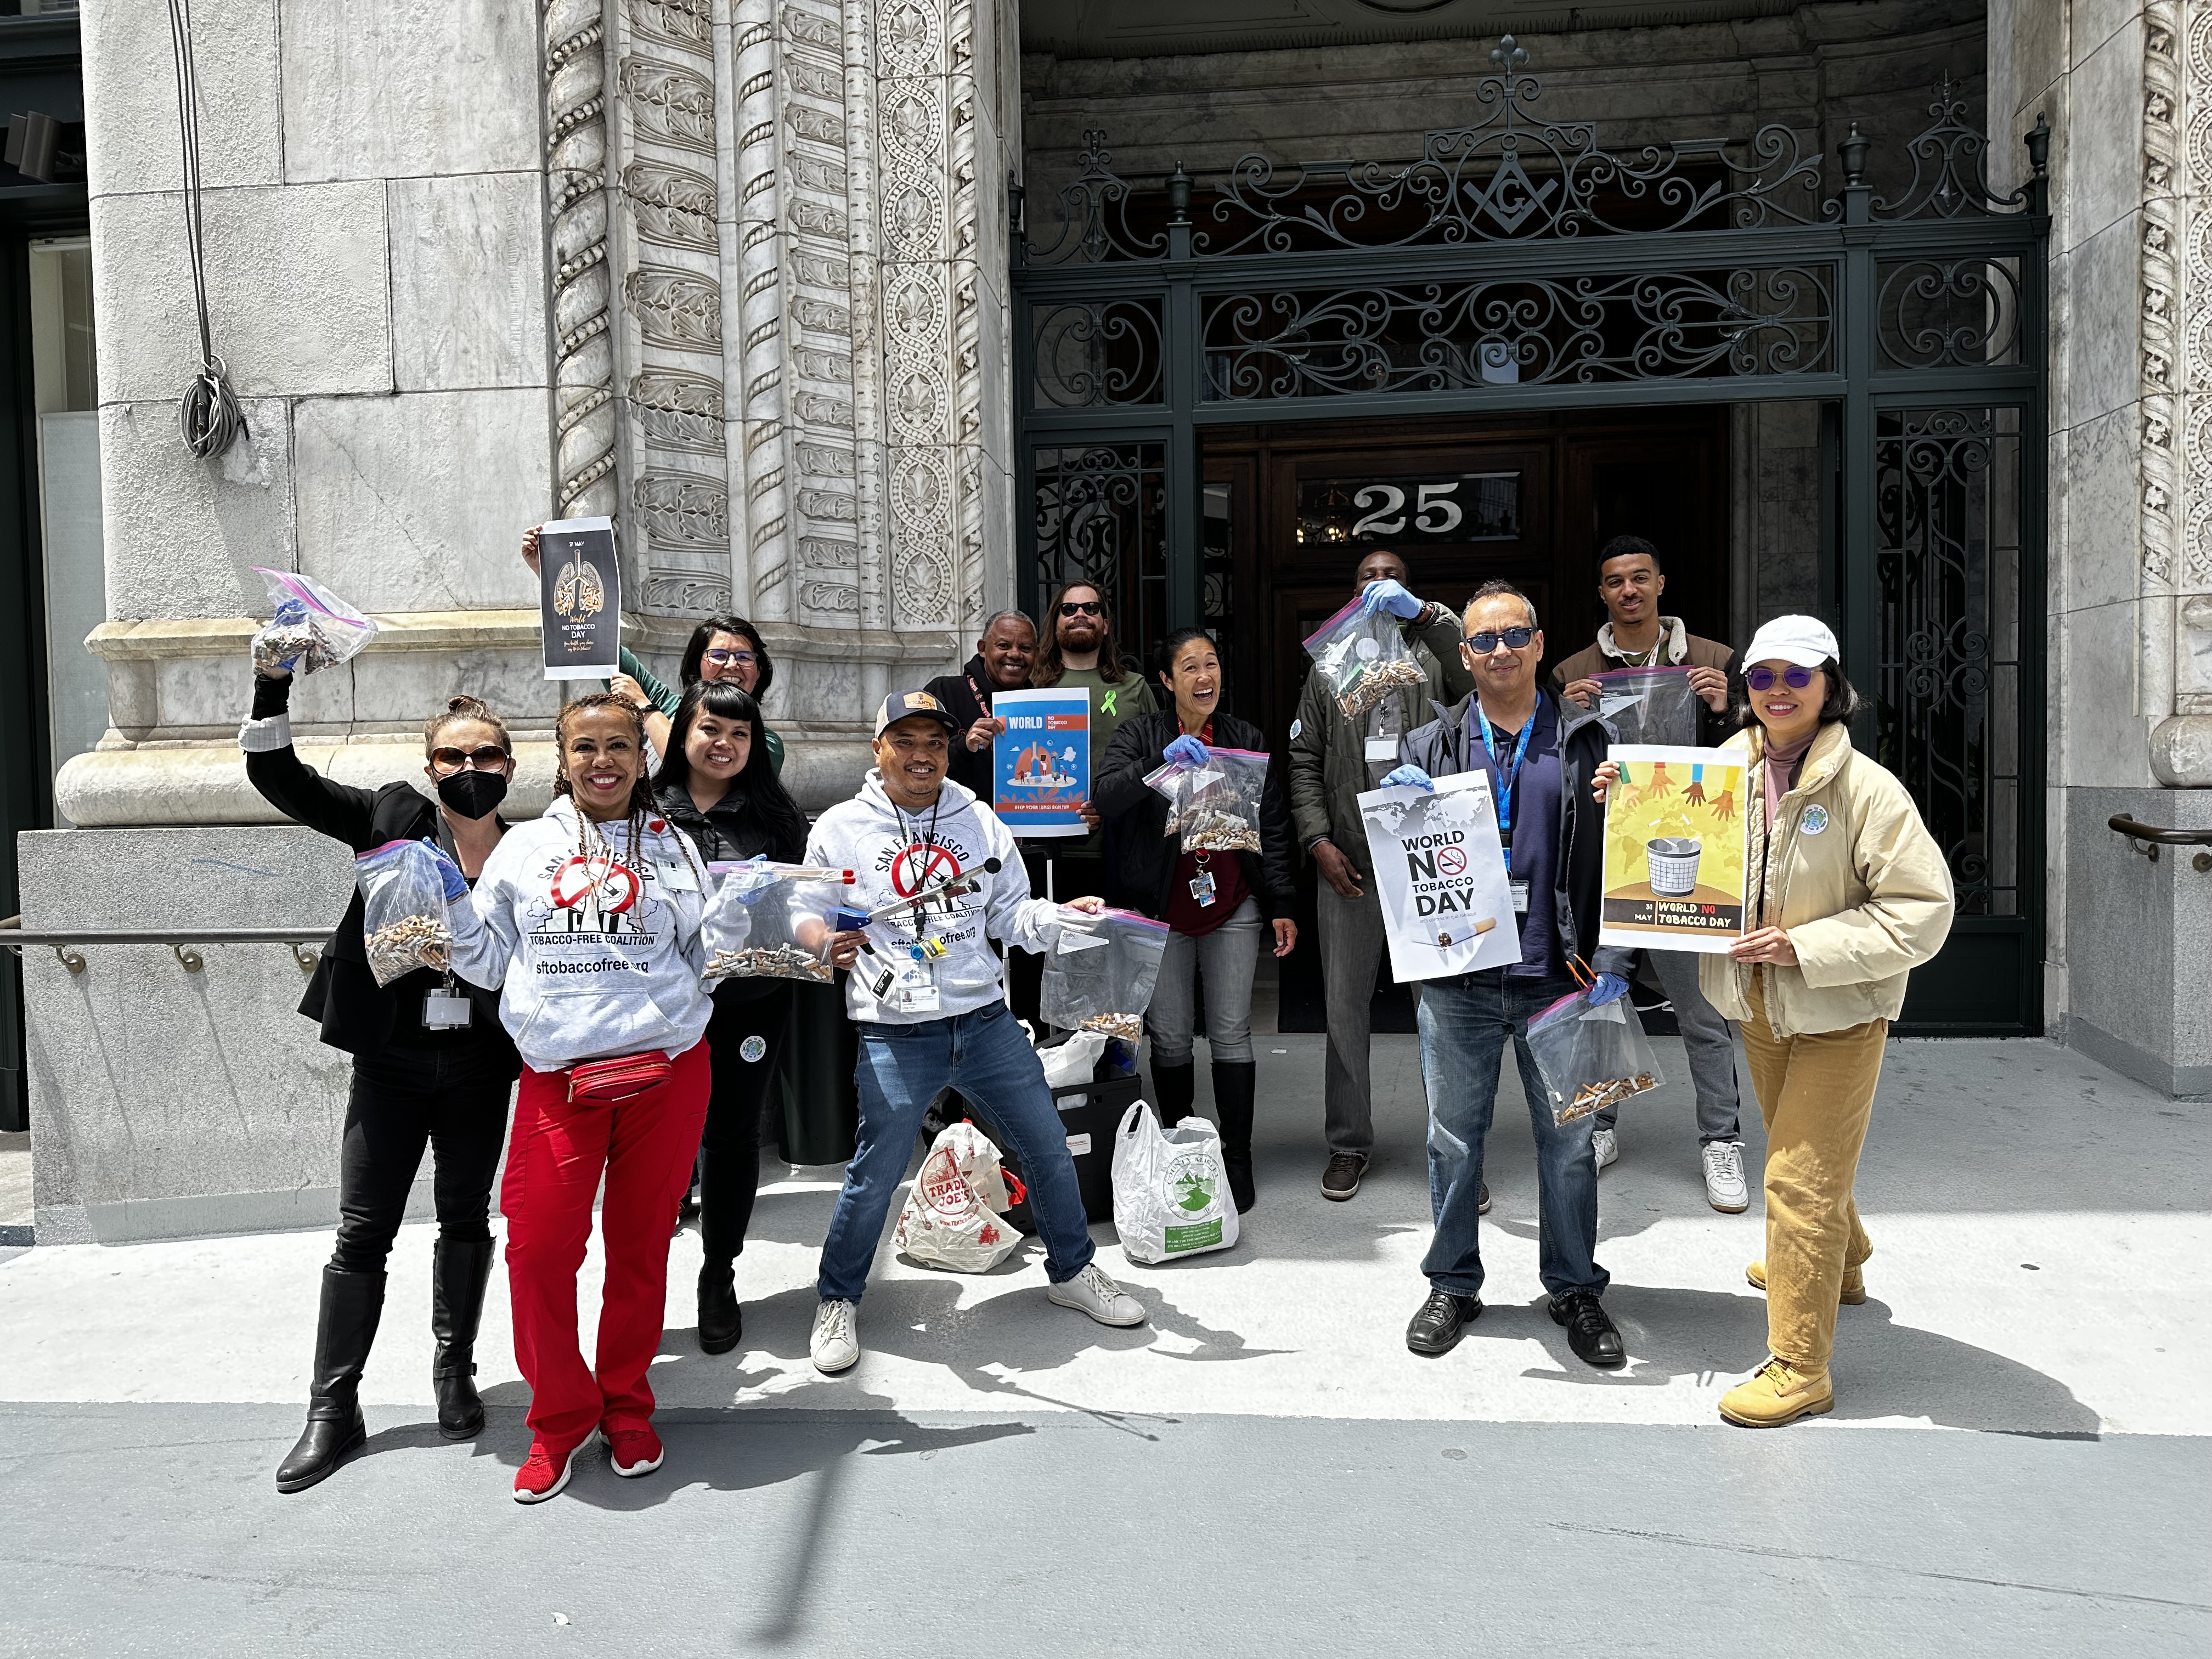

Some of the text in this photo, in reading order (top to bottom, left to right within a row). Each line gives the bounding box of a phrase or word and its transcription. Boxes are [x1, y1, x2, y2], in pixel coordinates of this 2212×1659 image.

[1352, 482, 1462, 534] 25
[569, 613, 586, 623] World
[1008, 716, 1042, 729] WORLD
[1401, 830, 1464, 851] WORLD
[538, 855, 565, 879] SAN
[875, 847, 896, 872] SAN
[1412, 877, 1473, 893] TOBACCO
[1415, 888, 1474, 917] DAY
[1658, 901, 1716, 914] WORLD NO
[1658, 914, 1731, 928] TOBACCO DAY
[530, 934, 654, 945] TOBACCO-FREE COALITION
[939, 1189, 970, 1207] JOE'S
